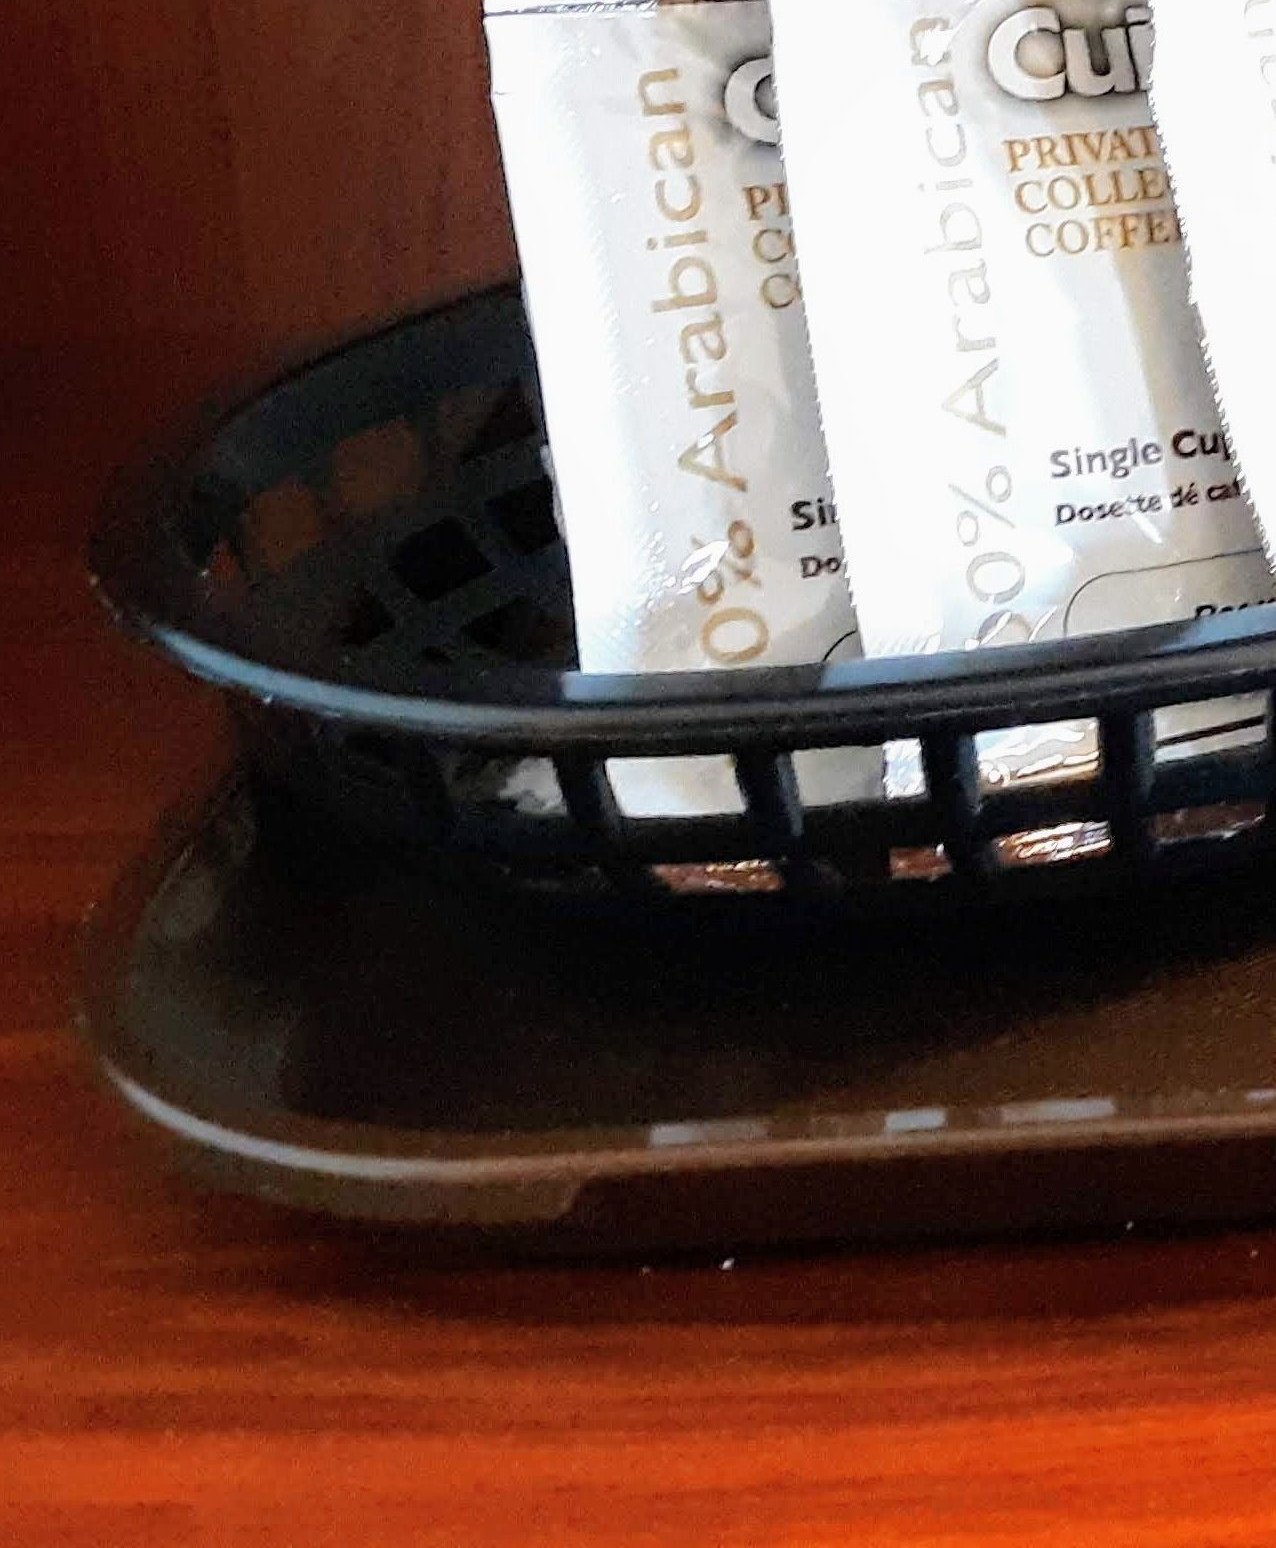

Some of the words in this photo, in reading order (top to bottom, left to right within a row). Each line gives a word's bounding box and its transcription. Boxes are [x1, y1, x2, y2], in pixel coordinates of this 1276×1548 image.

[638, 67, 749, 493] Arabican
[910, 16, 1007, 437] Arabican
[1013, 166, 1173, 214] COLLE
[1050, 437, 1164, 479] Single
